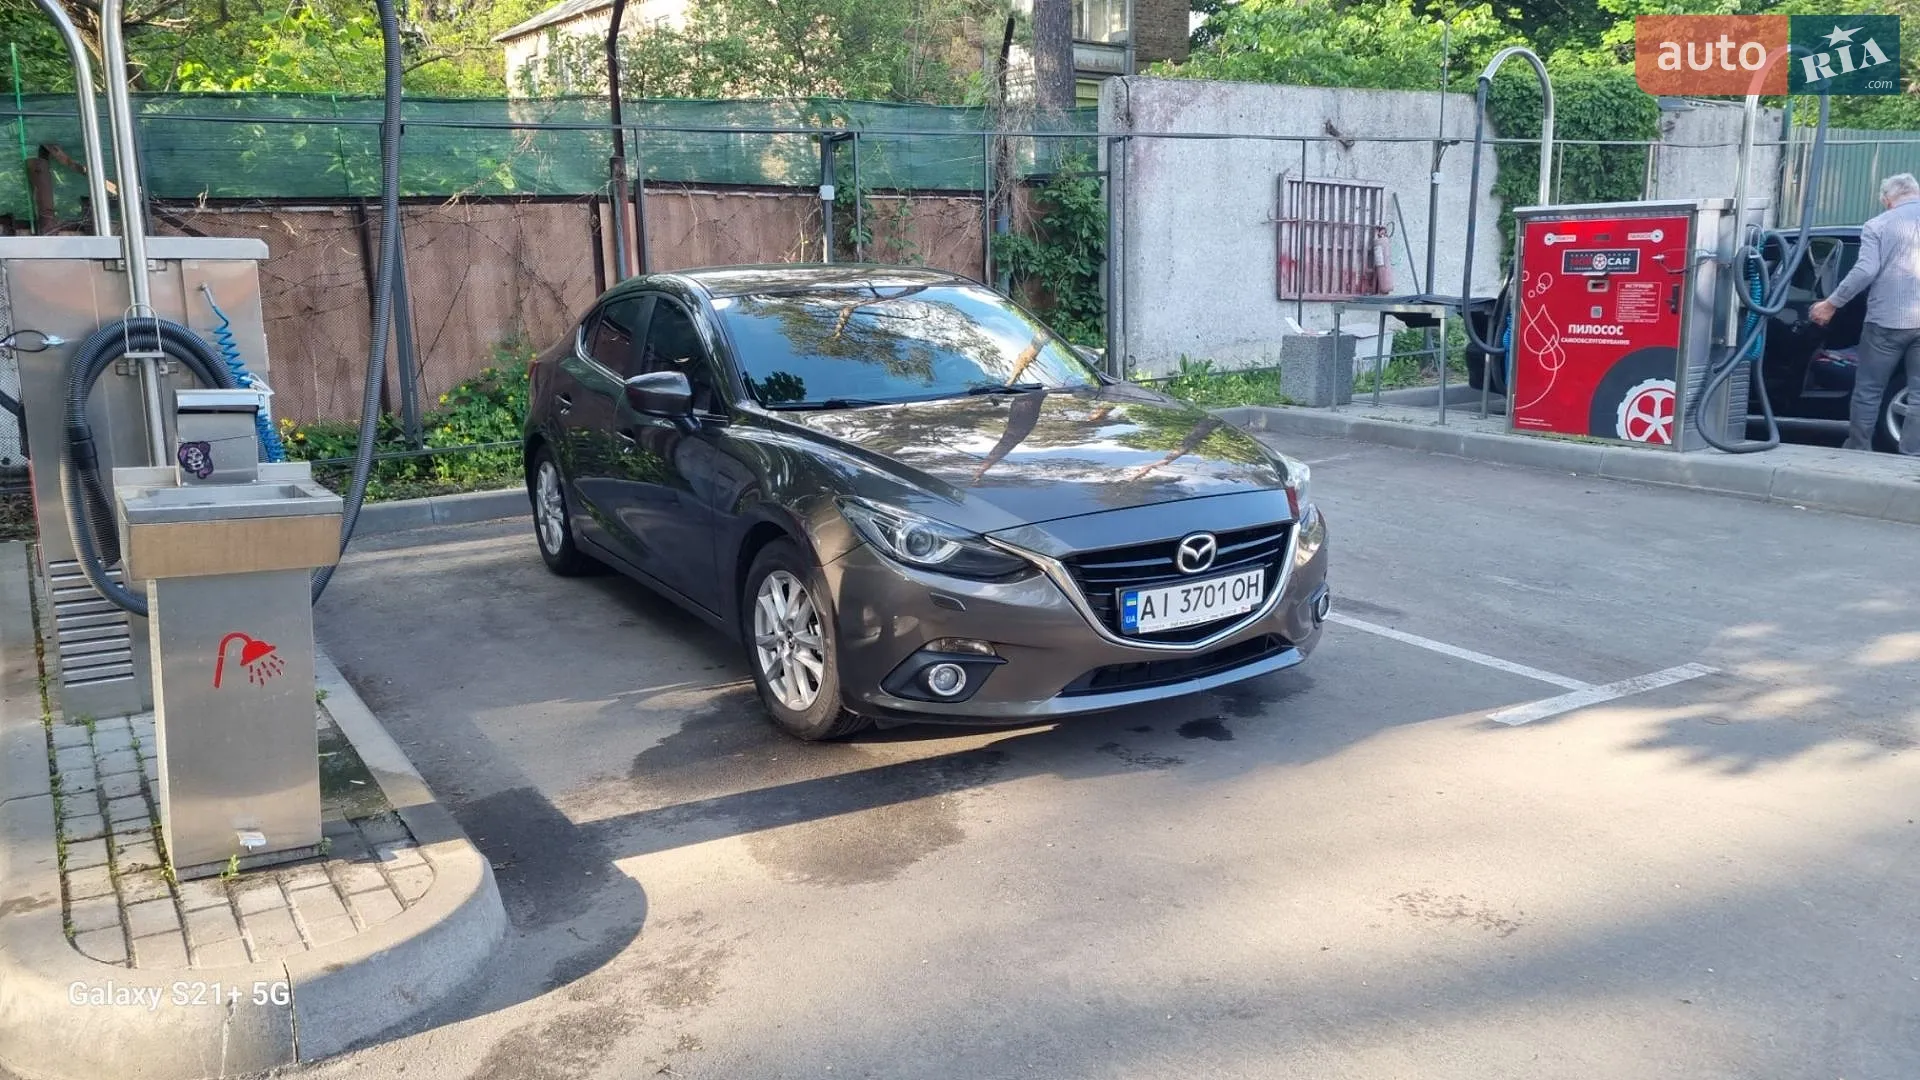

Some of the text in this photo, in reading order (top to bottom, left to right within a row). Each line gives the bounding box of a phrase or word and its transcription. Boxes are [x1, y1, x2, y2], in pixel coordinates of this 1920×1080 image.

[1607, 257, 1631, 265] CAR
[1568, 324, 1624, 335] ПИЛОСОС
[1180, 581, 1227, 613] 3701
[1232, 573, 1260, 601] OH
[1125, 615, 1136, 623] UA
